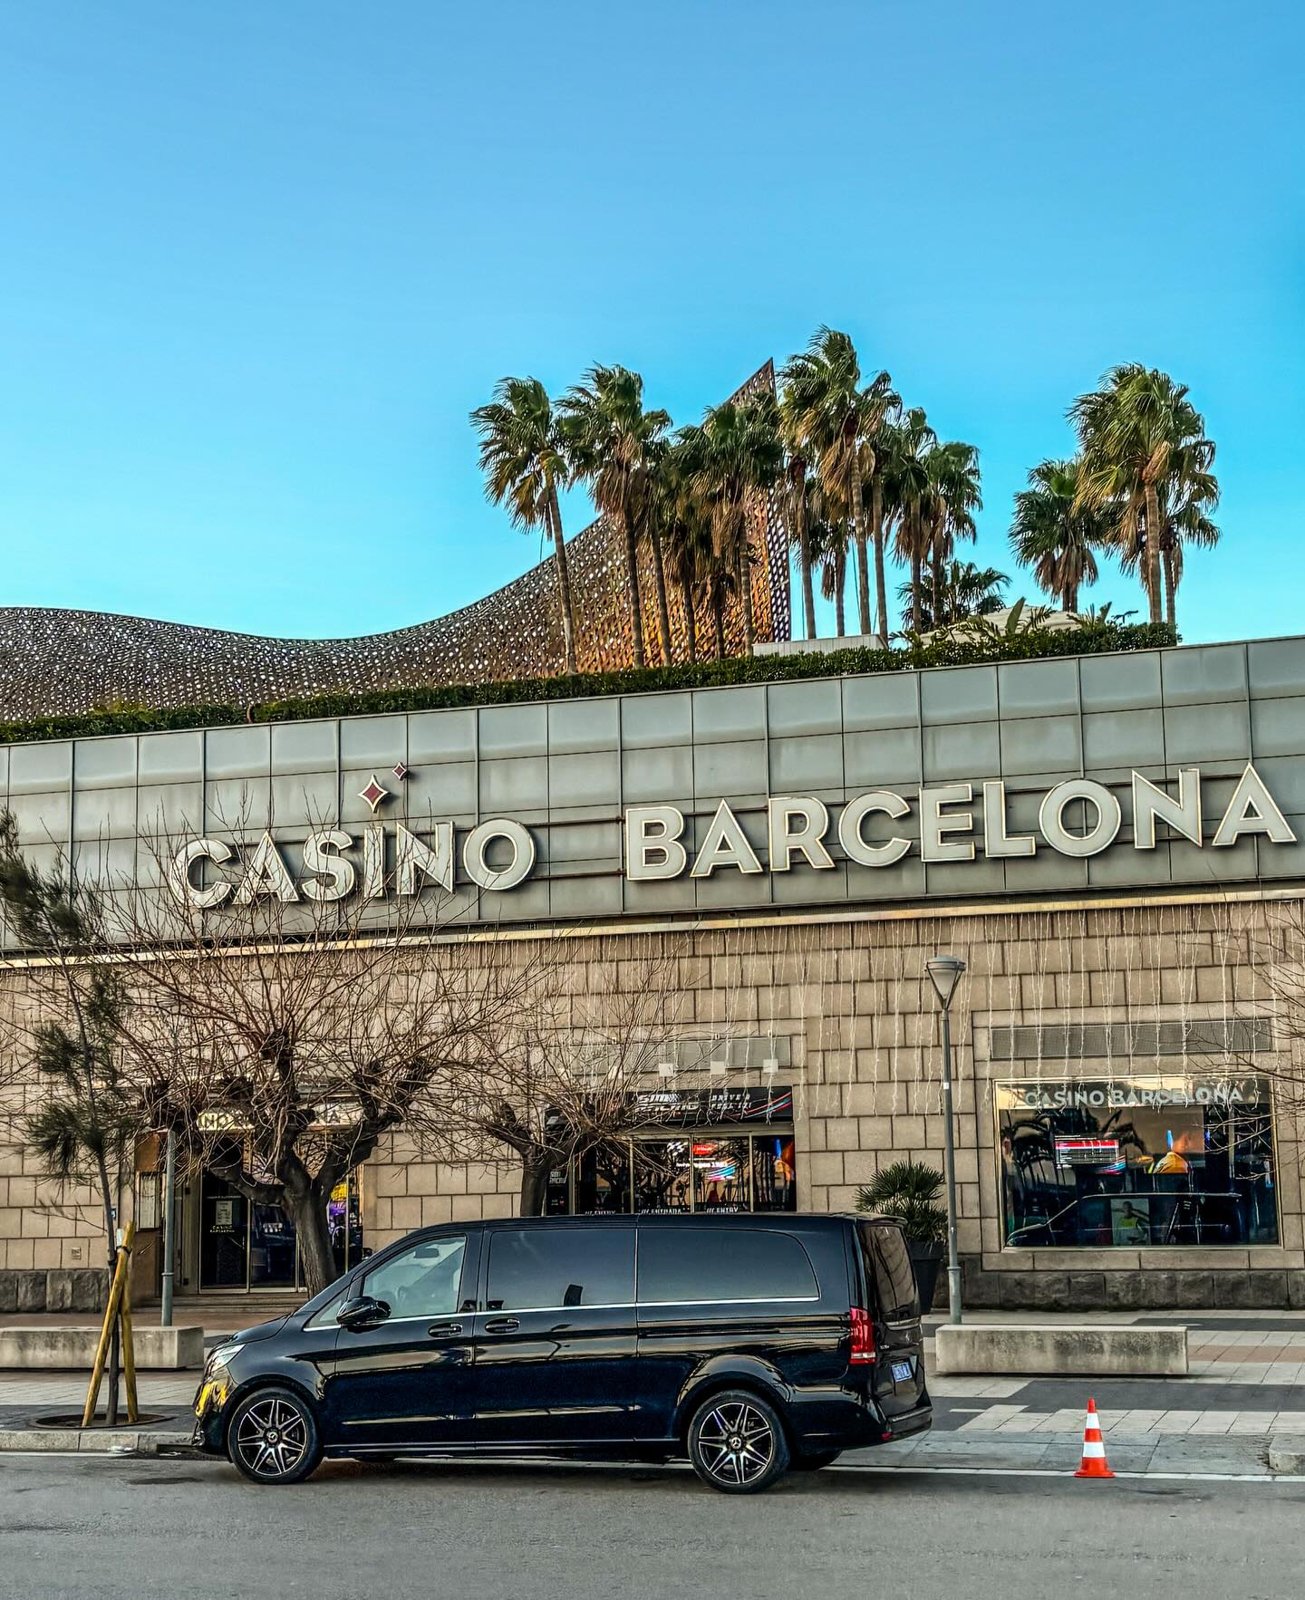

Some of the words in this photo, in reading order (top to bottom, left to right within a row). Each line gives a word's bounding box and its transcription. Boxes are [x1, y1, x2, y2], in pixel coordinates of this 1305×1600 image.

[168, 817, 536, 909] CASINO
[624, 761, 1297, 882] BARCELONA
[1024, 1089, 1105, 1107] CASINO
[1111, 1086, 1244, 1105] BARCELONA
